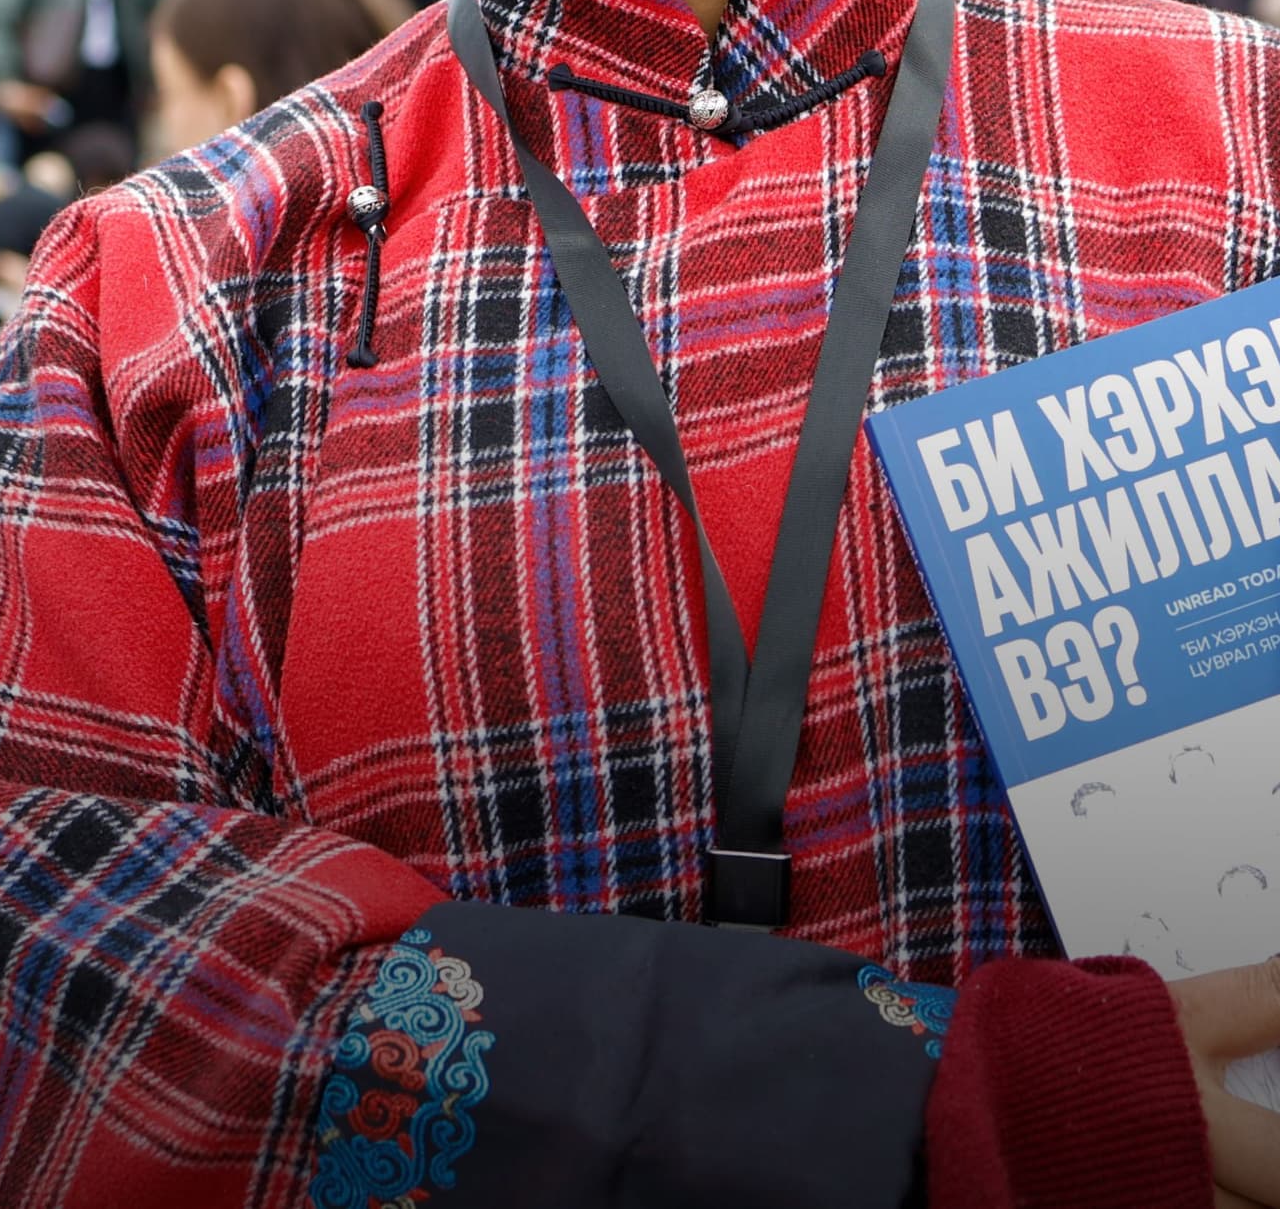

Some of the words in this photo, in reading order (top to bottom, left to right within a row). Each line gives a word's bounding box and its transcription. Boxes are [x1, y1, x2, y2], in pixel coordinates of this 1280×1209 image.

[917, 409, 1044, 532] БИ
[1165, 581, 1238, 616] UNREAD
[993, 605, 1148, 742] ВЭ?
[1189, 642, 1259, 679] ЦУВРАЛ
